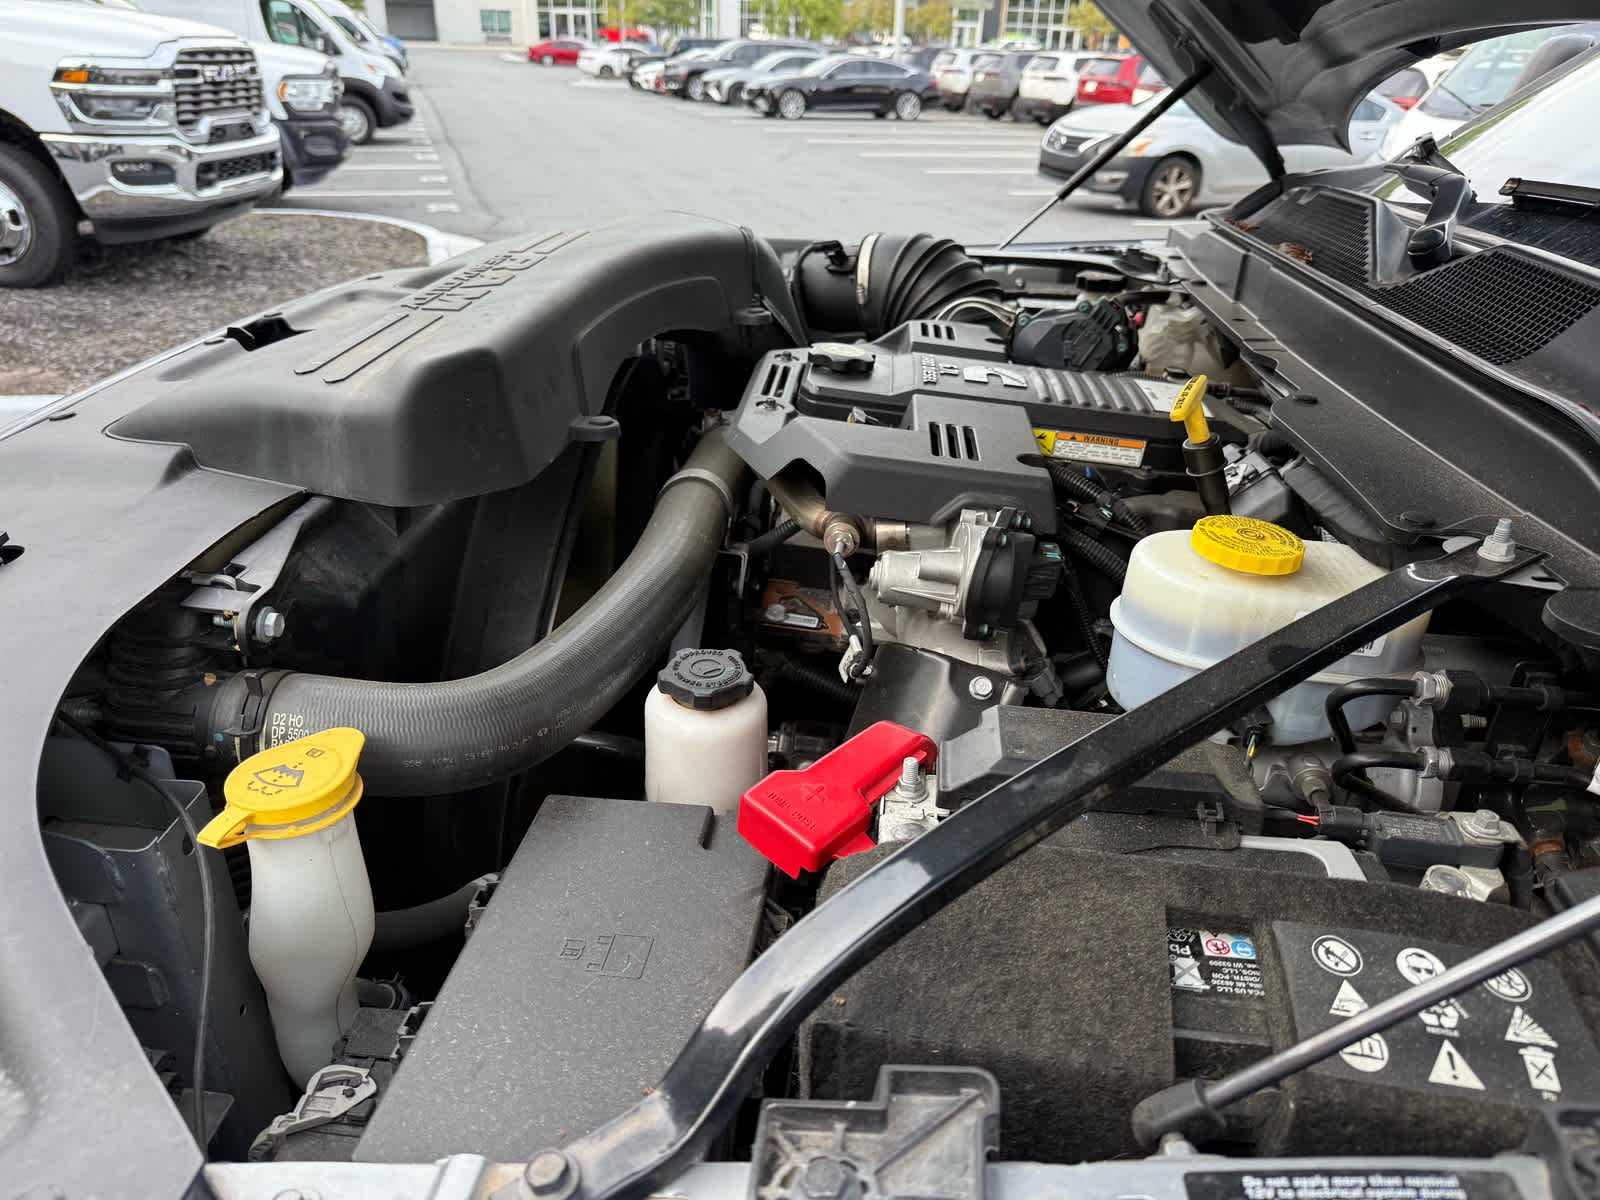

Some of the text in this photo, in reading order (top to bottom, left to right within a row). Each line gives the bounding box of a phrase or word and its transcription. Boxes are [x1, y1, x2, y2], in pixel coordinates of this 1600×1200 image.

[1083, 435, 1120, 447] WARNING
[272, 713, 304, 728] D2 HO
[271, 726, 286, 739] DP
[1169, 943, 1192, 956] Pb
